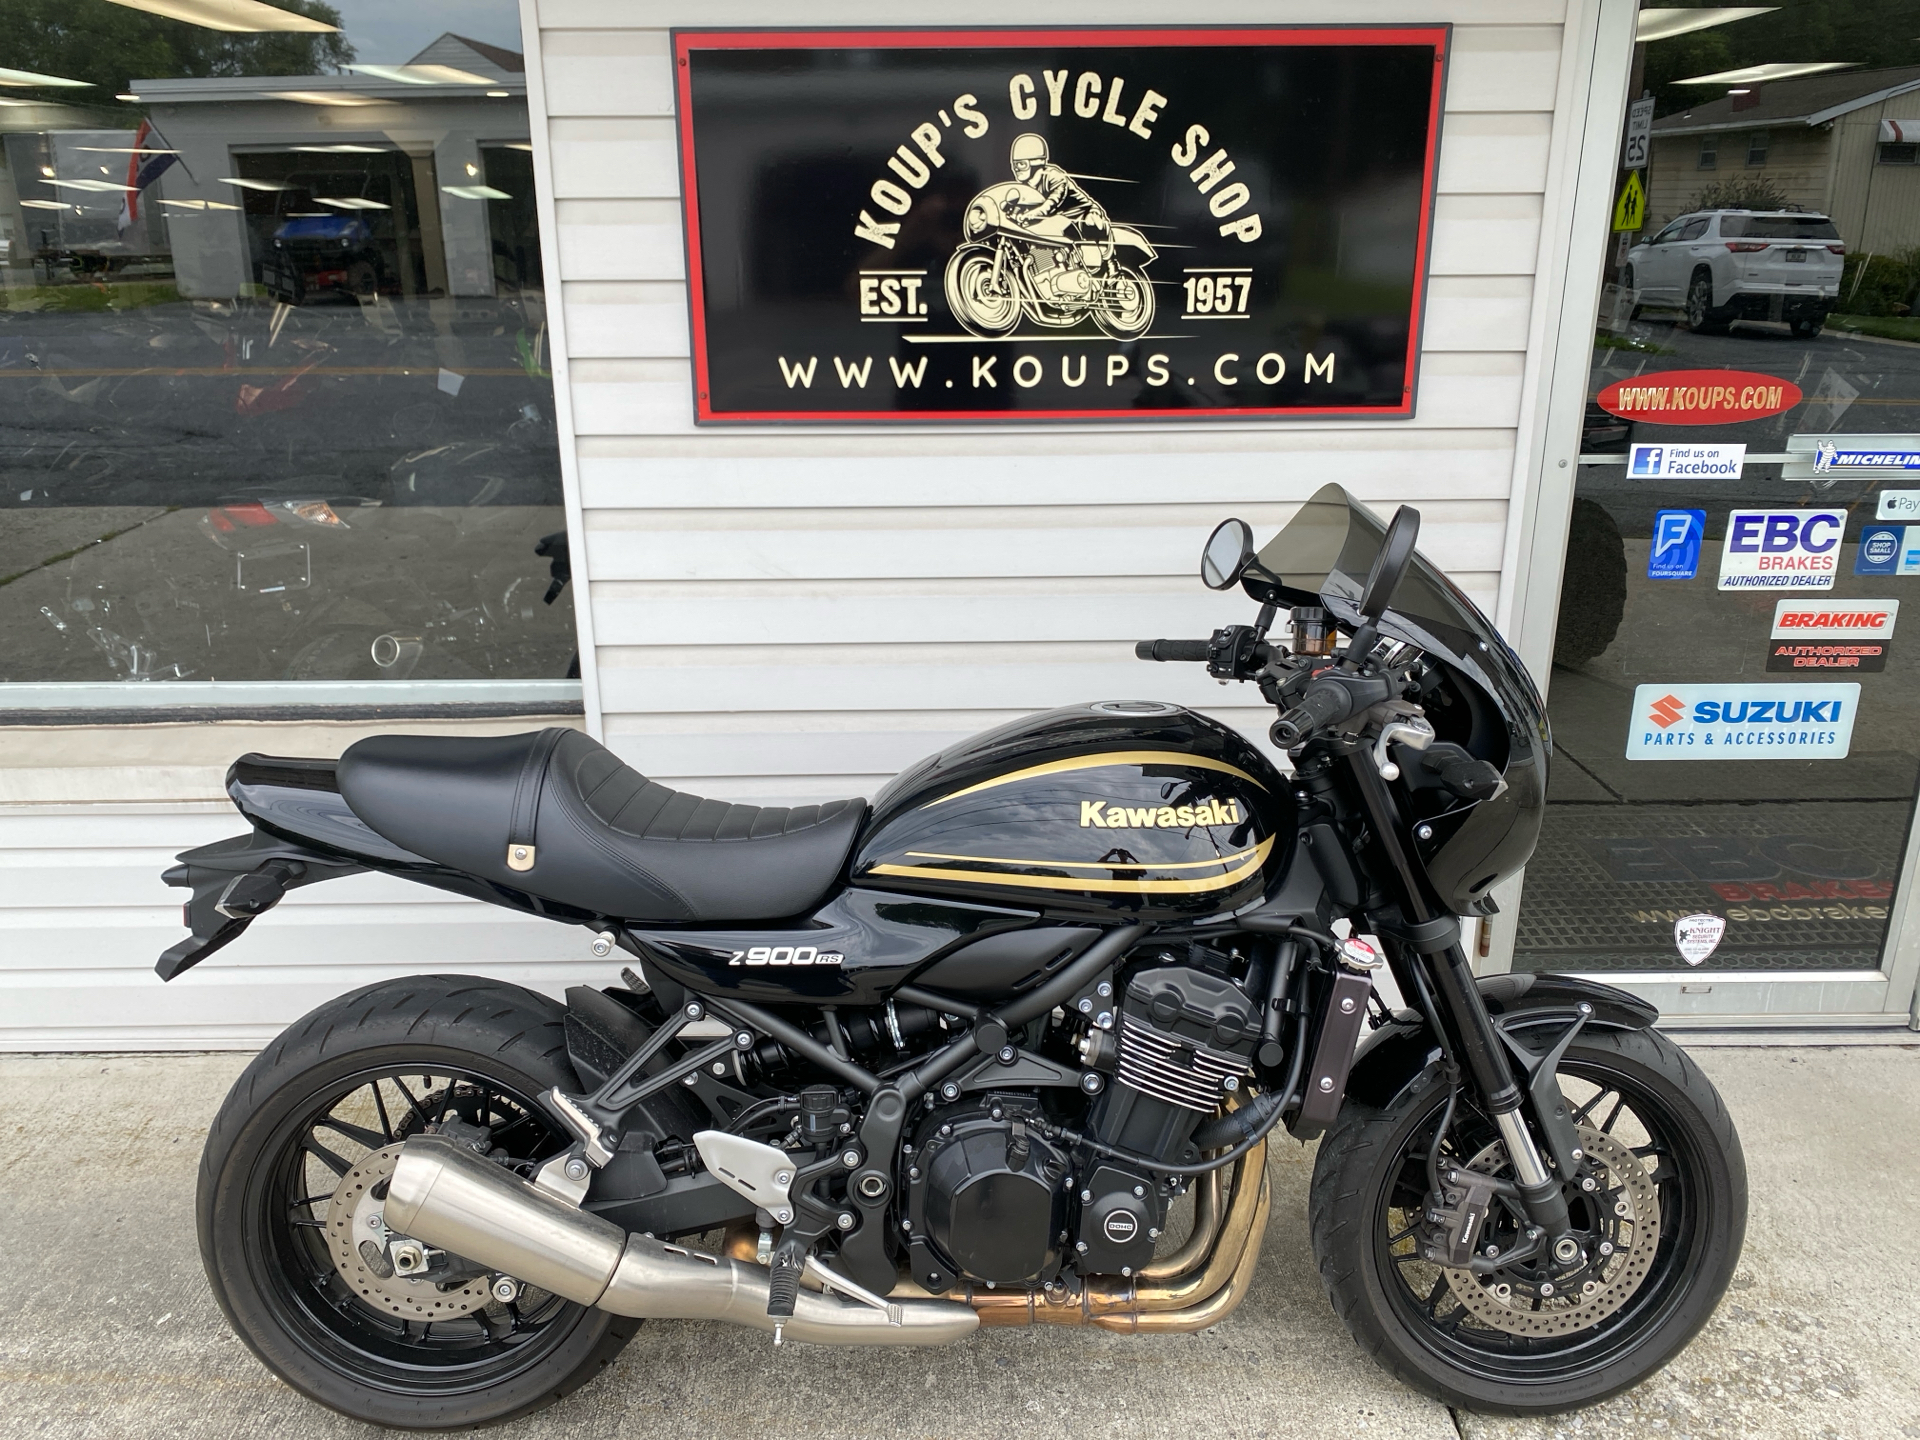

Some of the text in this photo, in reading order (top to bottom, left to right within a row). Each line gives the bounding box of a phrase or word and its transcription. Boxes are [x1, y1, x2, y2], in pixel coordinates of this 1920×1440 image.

[854, 70, 1262, 250] KOUP'S CYCLE SHOP
[860, 278, 928, 315] EST.
[1182, 276, 1252, 313] 1957
[778, 352, 1336, 389] WWW.KOUPS.COM
[1618, 385, 1783, 411] WWW.KOUPS.COM
[1669, 448, 1720, 458] Find us on
[1836, 454, 1920, 465] MICHELIN
[1667, 459, 1737, 474] Facebook
[1899, 497, 1920, 513] Pay
[1729, 513, 1840, 553] EBC
[1758, 556, 1833, 570] BRAKES
[1723, 575, 1831, 587] AUTHORIZED DEALER
[1778, 612, 1889, 628] BRAKING
[1774, 645, 1883, 656] AUTHORIZED
[1792, 656, 1861, 668] DEALER
[1692, 700, 1843, 724] SUZUKI
[1644, 731, 1836, 745] PARTS & ACCESSORIES
[1080, 798, 1240, 828] Kawasaki
[1461, 1212, 1476, 1244] Kawasaki
